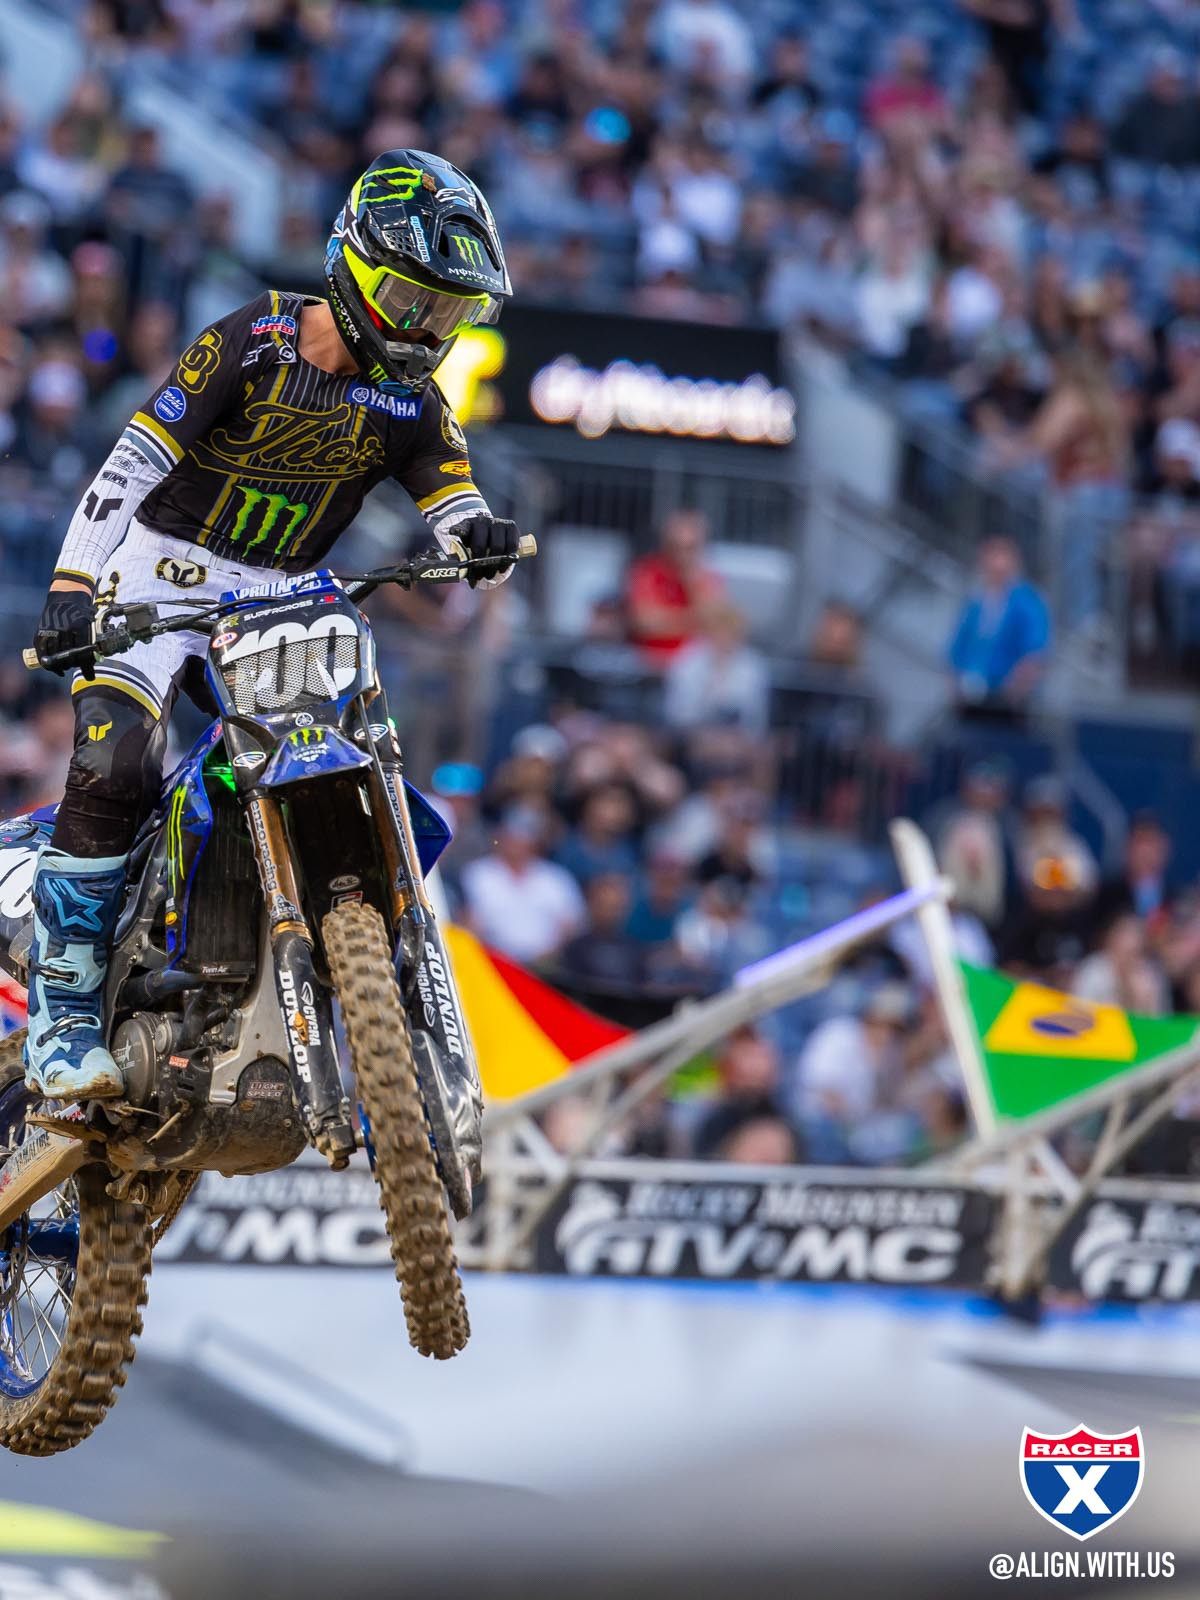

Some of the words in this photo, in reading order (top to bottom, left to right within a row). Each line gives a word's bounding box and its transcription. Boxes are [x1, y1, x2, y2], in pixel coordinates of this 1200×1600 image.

[448, 267, 503, 289] MONSTER
[370, 388, 417, 417] YAMAHA
[420, 567, 458, 578] ARC
[243, 600, 314, 621] SUPERCROSS
[221, 614, 358, 716] 100
[425, 941, 464, 1058] DUNLOP
[279, 969, 312, 1083] DUNLOP
[303, 1005, 321, 1046] CYCRA
[626, 1182, 751, 1222] ROCKY
[756, 1183, 963, 1229] MOUNTAIN
